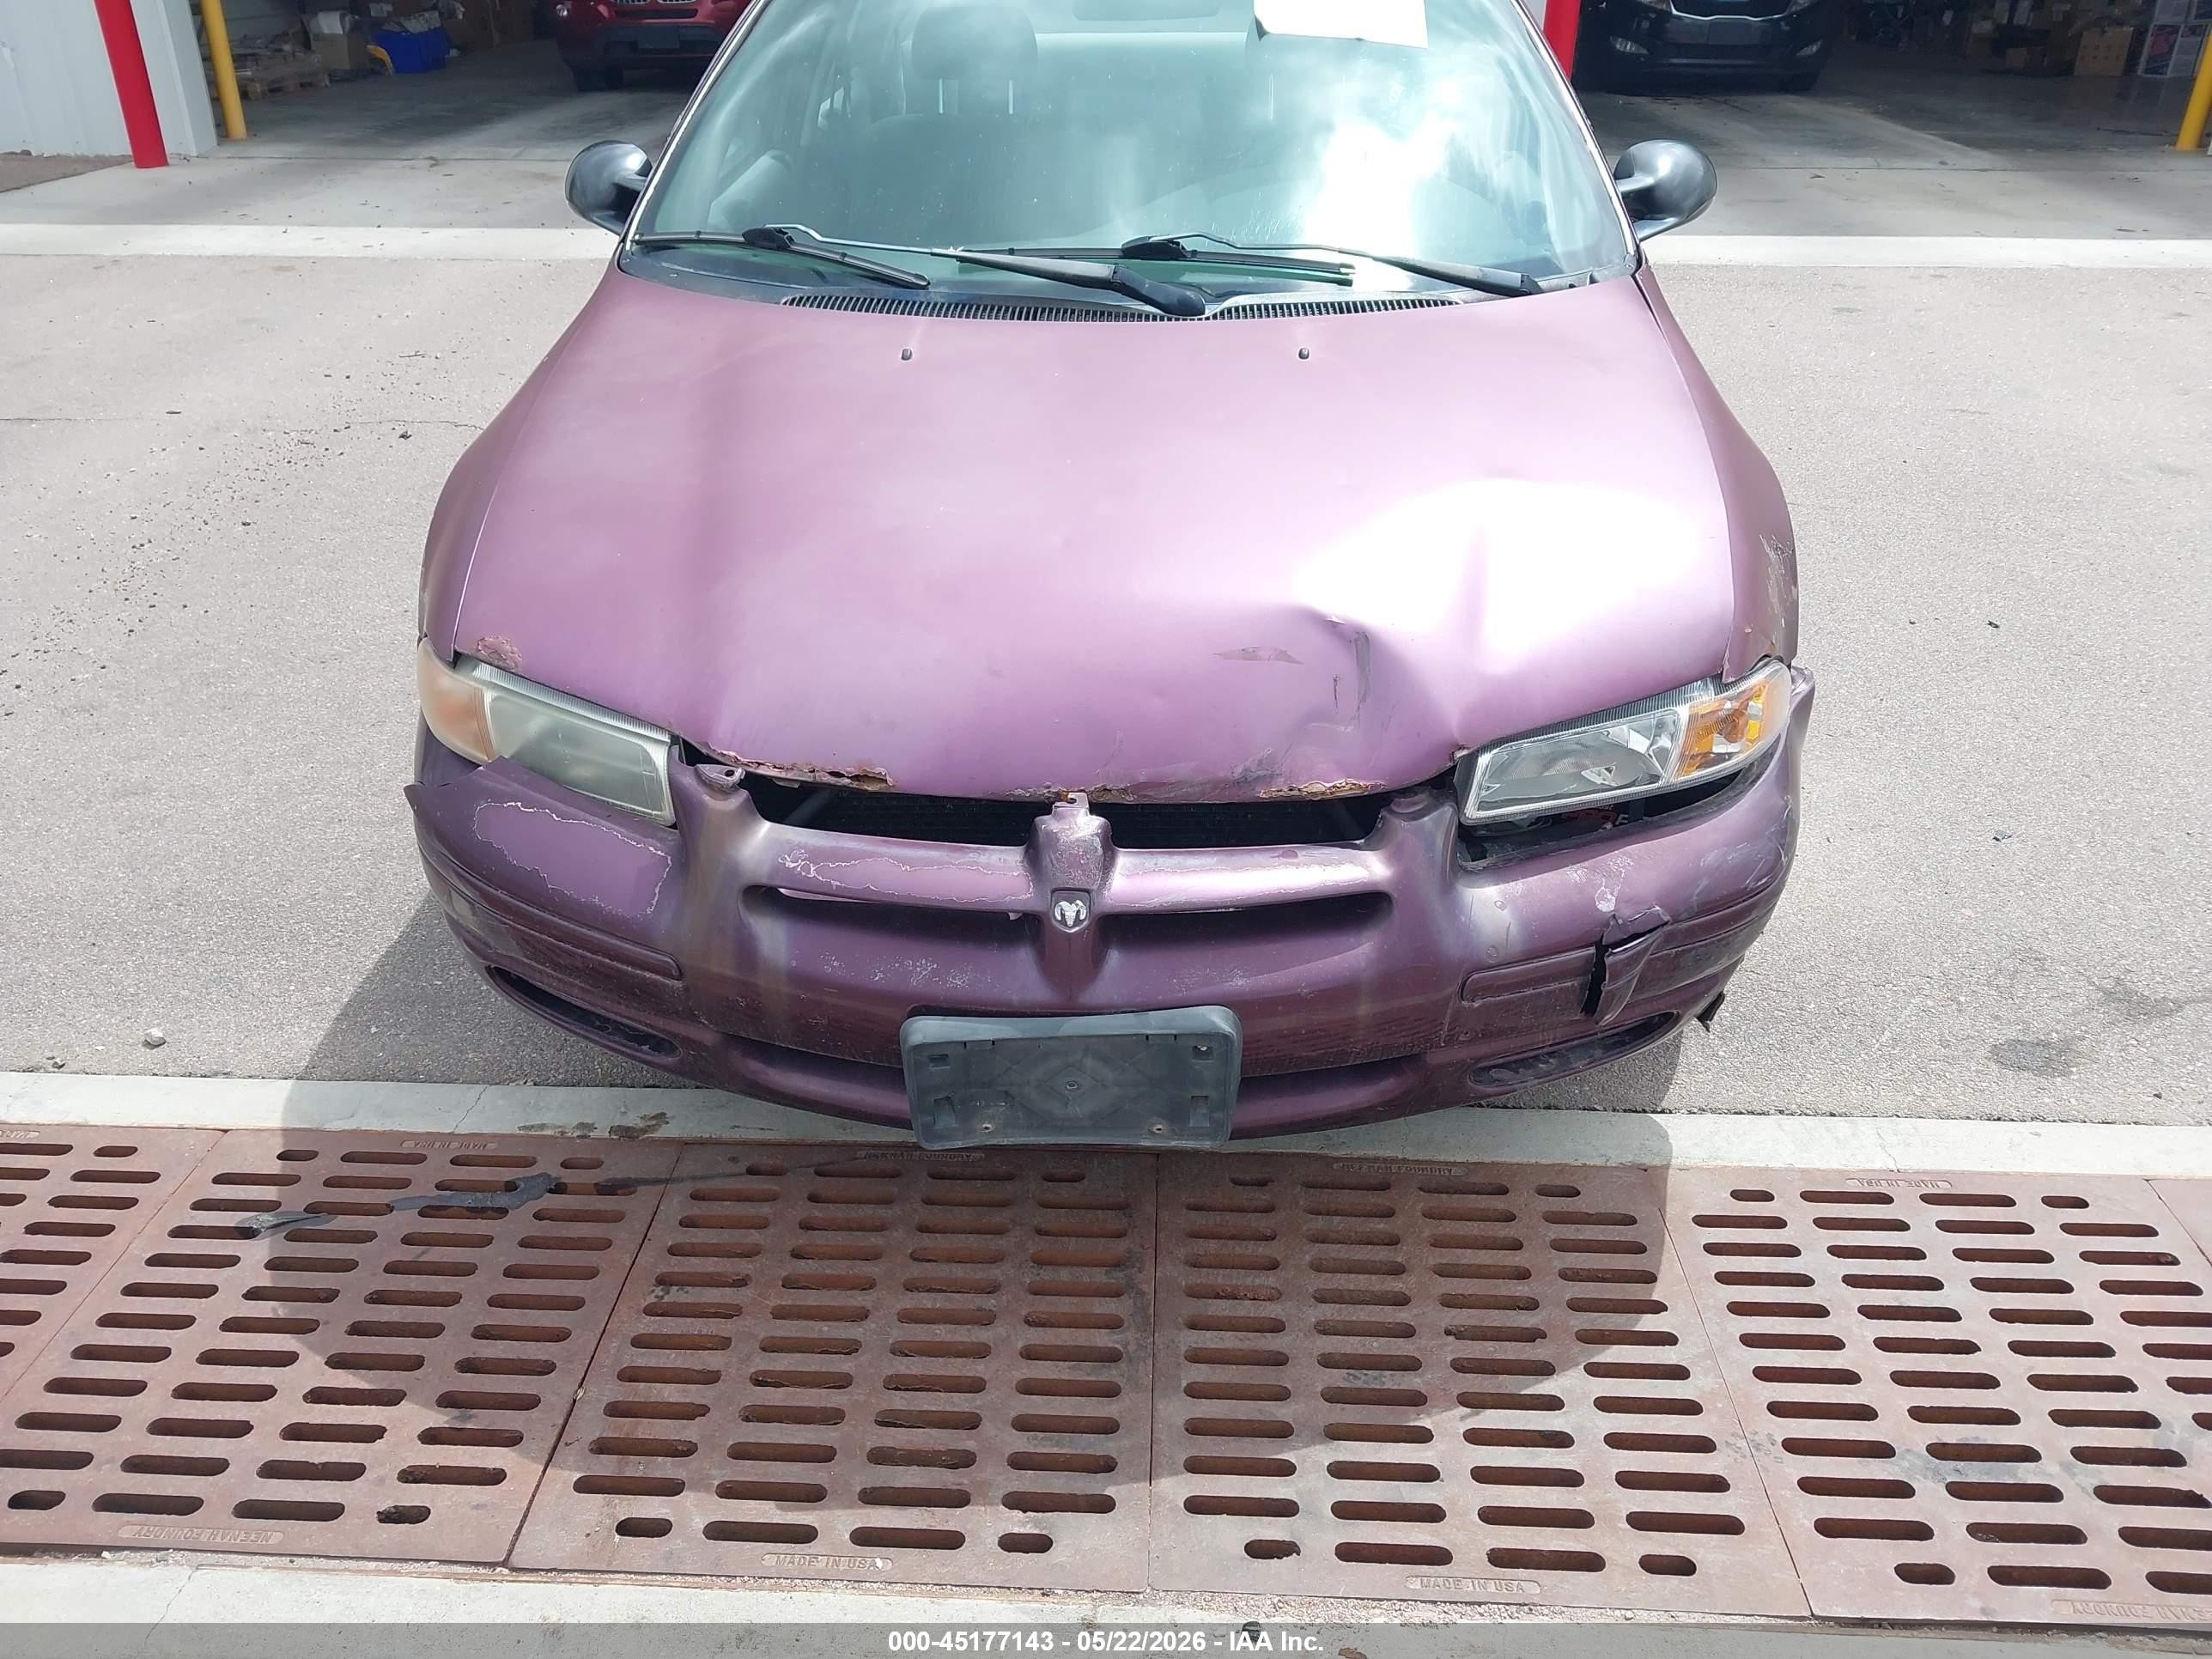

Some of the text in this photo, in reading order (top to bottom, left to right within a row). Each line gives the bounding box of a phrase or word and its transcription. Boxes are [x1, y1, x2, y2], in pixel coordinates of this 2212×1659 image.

[132, 1525, 274, 1543] NEENAH FOUNDRY
[775, 1555, 878, 1571] MADE IN USA
[1419, 1577, 1463, 1589] MADE
[1493, 1580, 1526, 1593] USA
